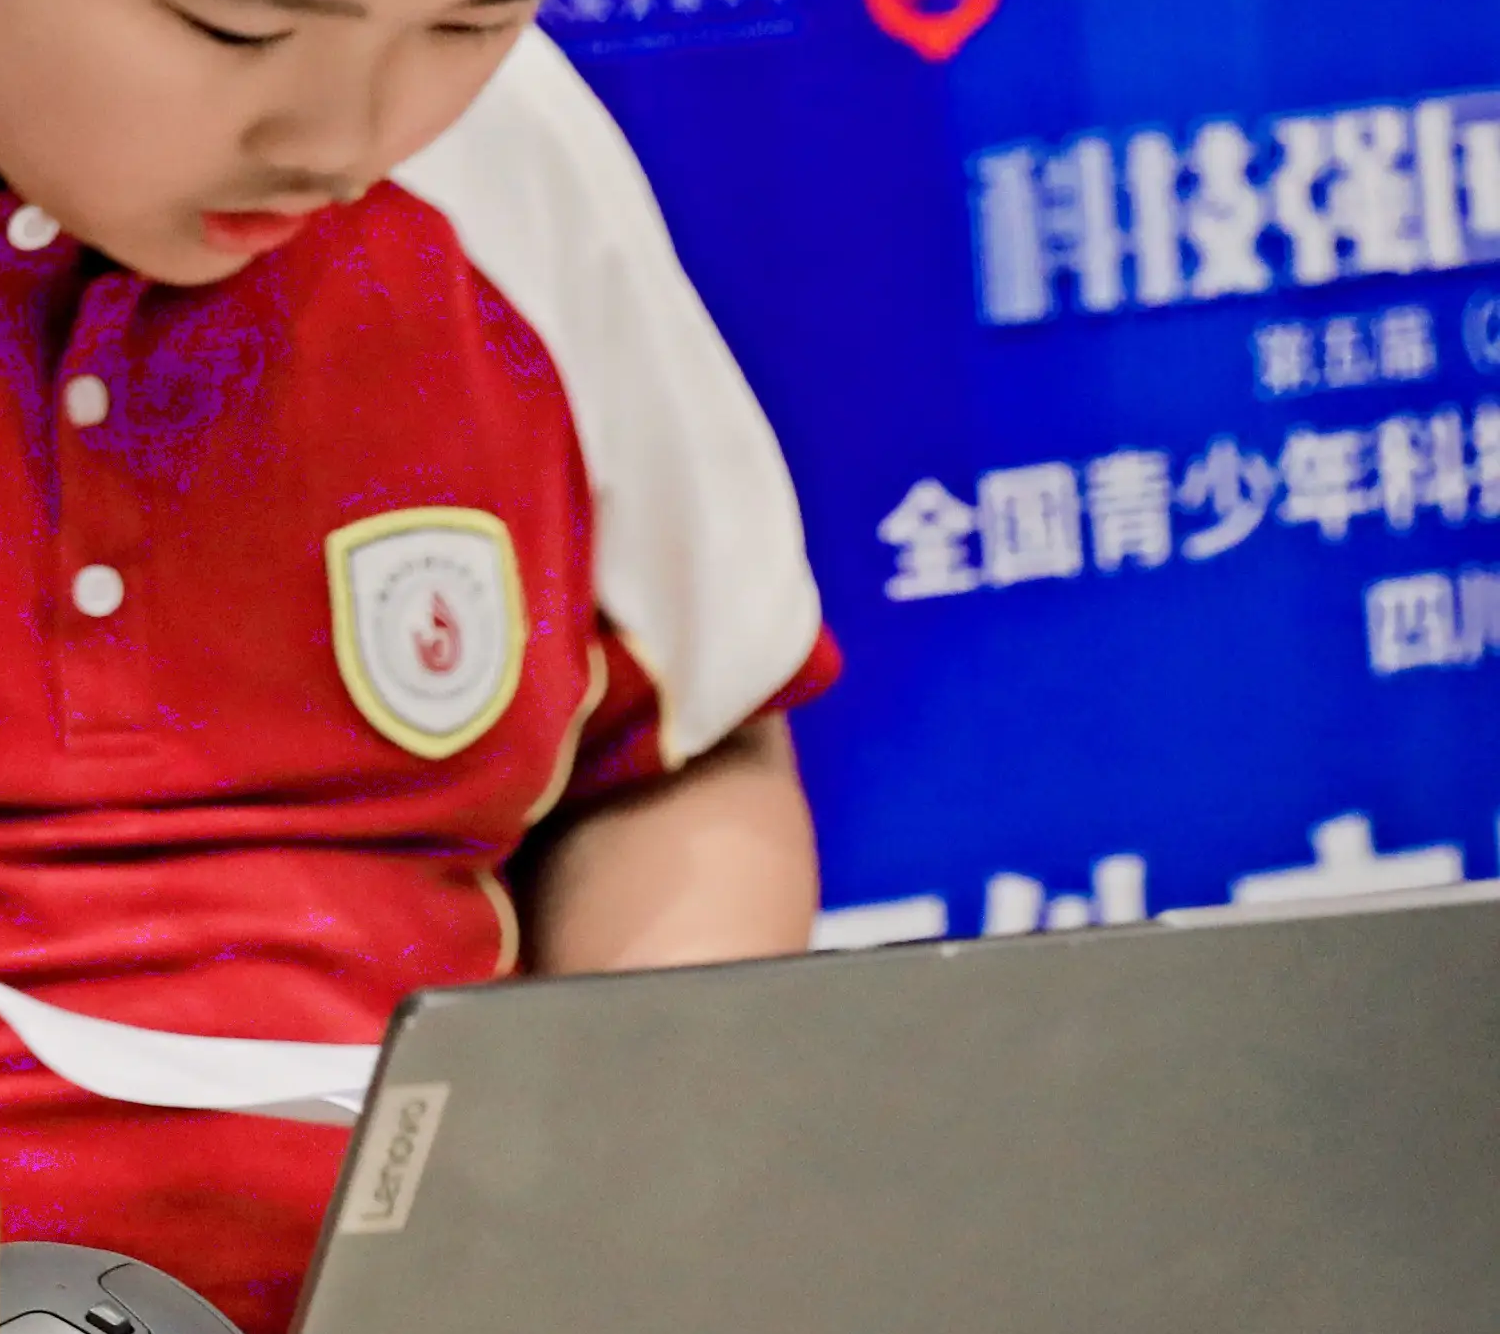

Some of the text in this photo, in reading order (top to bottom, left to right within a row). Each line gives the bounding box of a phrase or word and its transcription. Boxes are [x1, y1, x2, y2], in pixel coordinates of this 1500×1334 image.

[877, 400, 1500, 603] 全国青少年科
